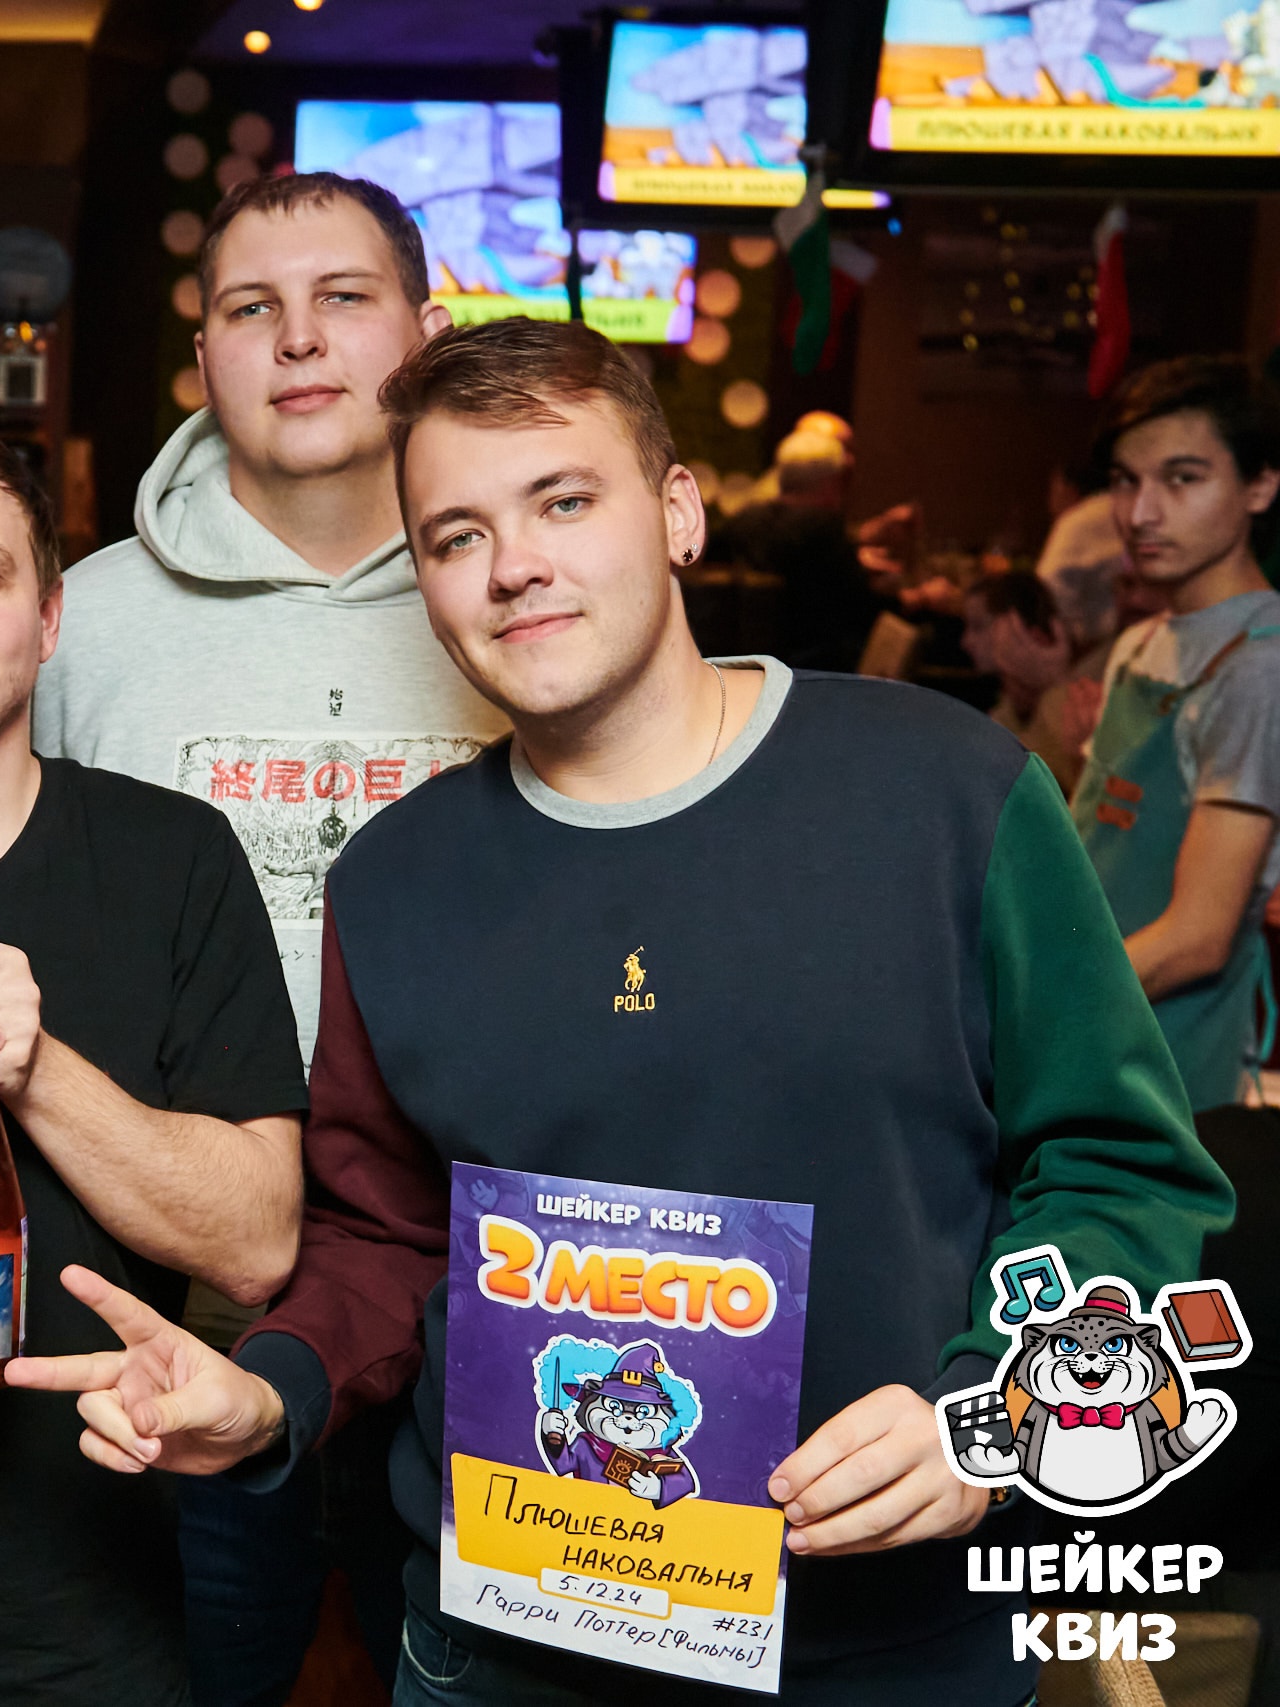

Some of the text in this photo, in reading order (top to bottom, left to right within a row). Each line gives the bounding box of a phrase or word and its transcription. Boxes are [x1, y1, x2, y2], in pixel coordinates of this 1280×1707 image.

[614, 993, 656, 1013] POLO
[536, 1193, 722, 1237] ШЕЙКЕР КВИЗ
[484, 1222, 770, 1330] 2 МЕСТО
[476, 1584, 560, 1624] Гарри
